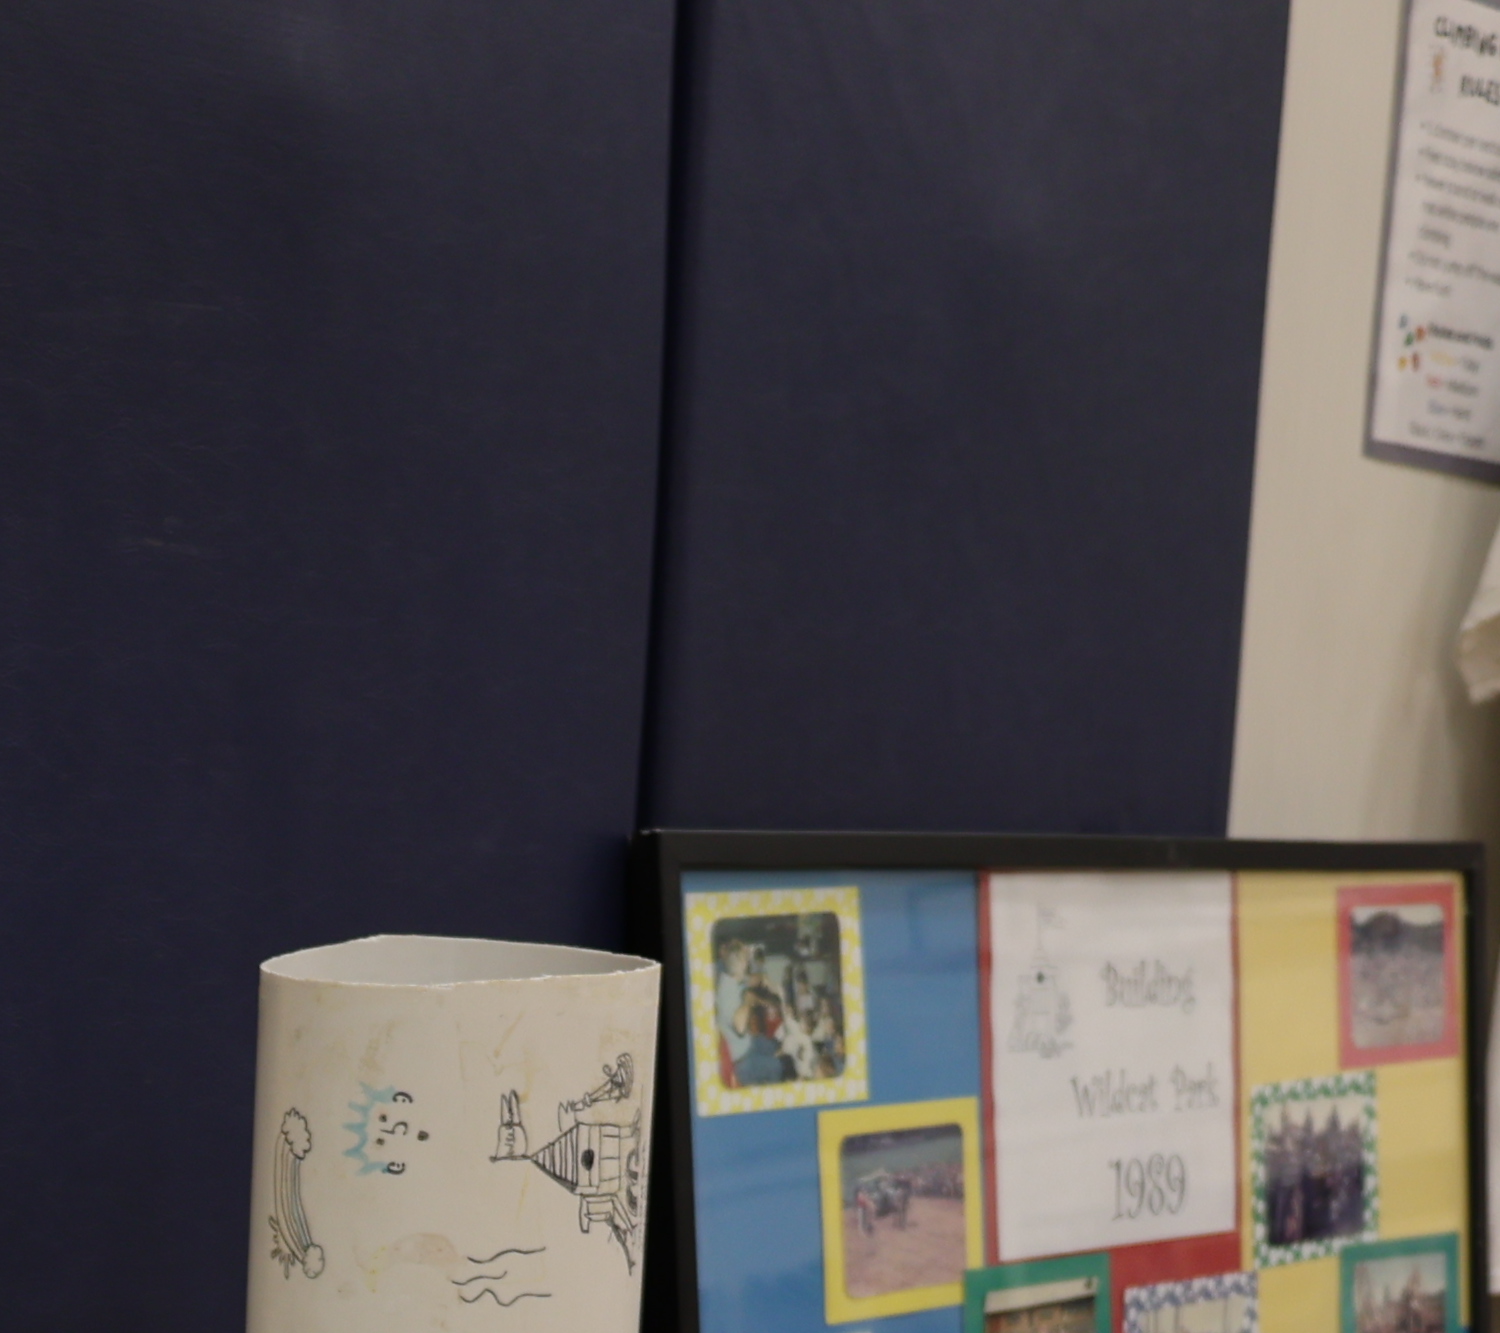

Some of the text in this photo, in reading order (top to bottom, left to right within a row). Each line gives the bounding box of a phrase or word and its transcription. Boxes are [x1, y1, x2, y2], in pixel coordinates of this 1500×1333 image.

[1101, 959, 1197, 1014] Building
[1070, 1062, 1220, 1117] Wildcat Park
[1109, 1153, 1186, 1221] 1989
